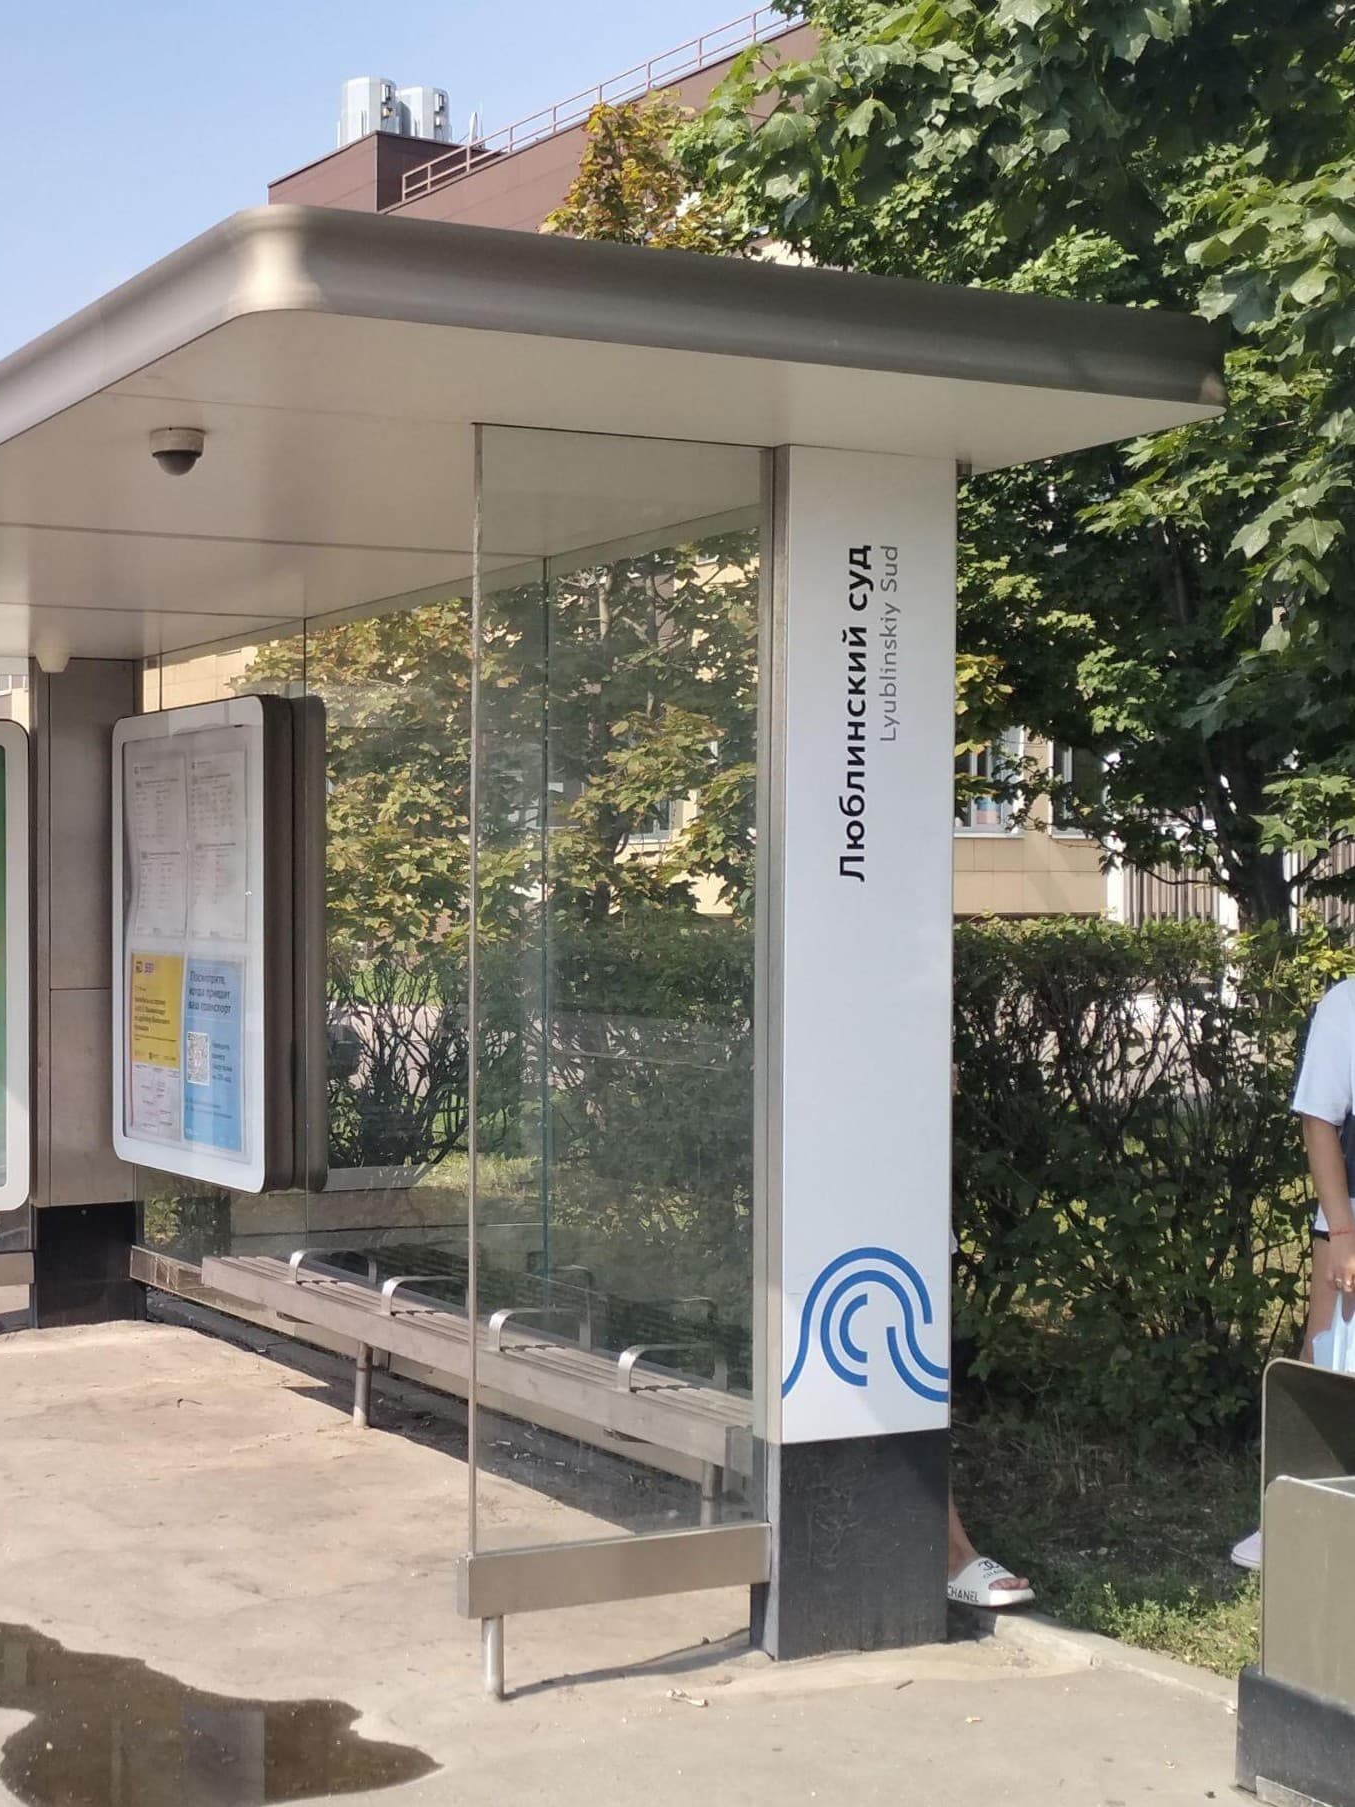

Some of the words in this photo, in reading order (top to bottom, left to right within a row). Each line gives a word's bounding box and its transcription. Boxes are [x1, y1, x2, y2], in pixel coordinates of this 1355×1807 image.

[848, 545, 873, 611] суд
[880, 545, 899, 592] Sud
[879, 602, 900, 741] Lyublinskiy
[839, 625, 868, 882] Люблинский
